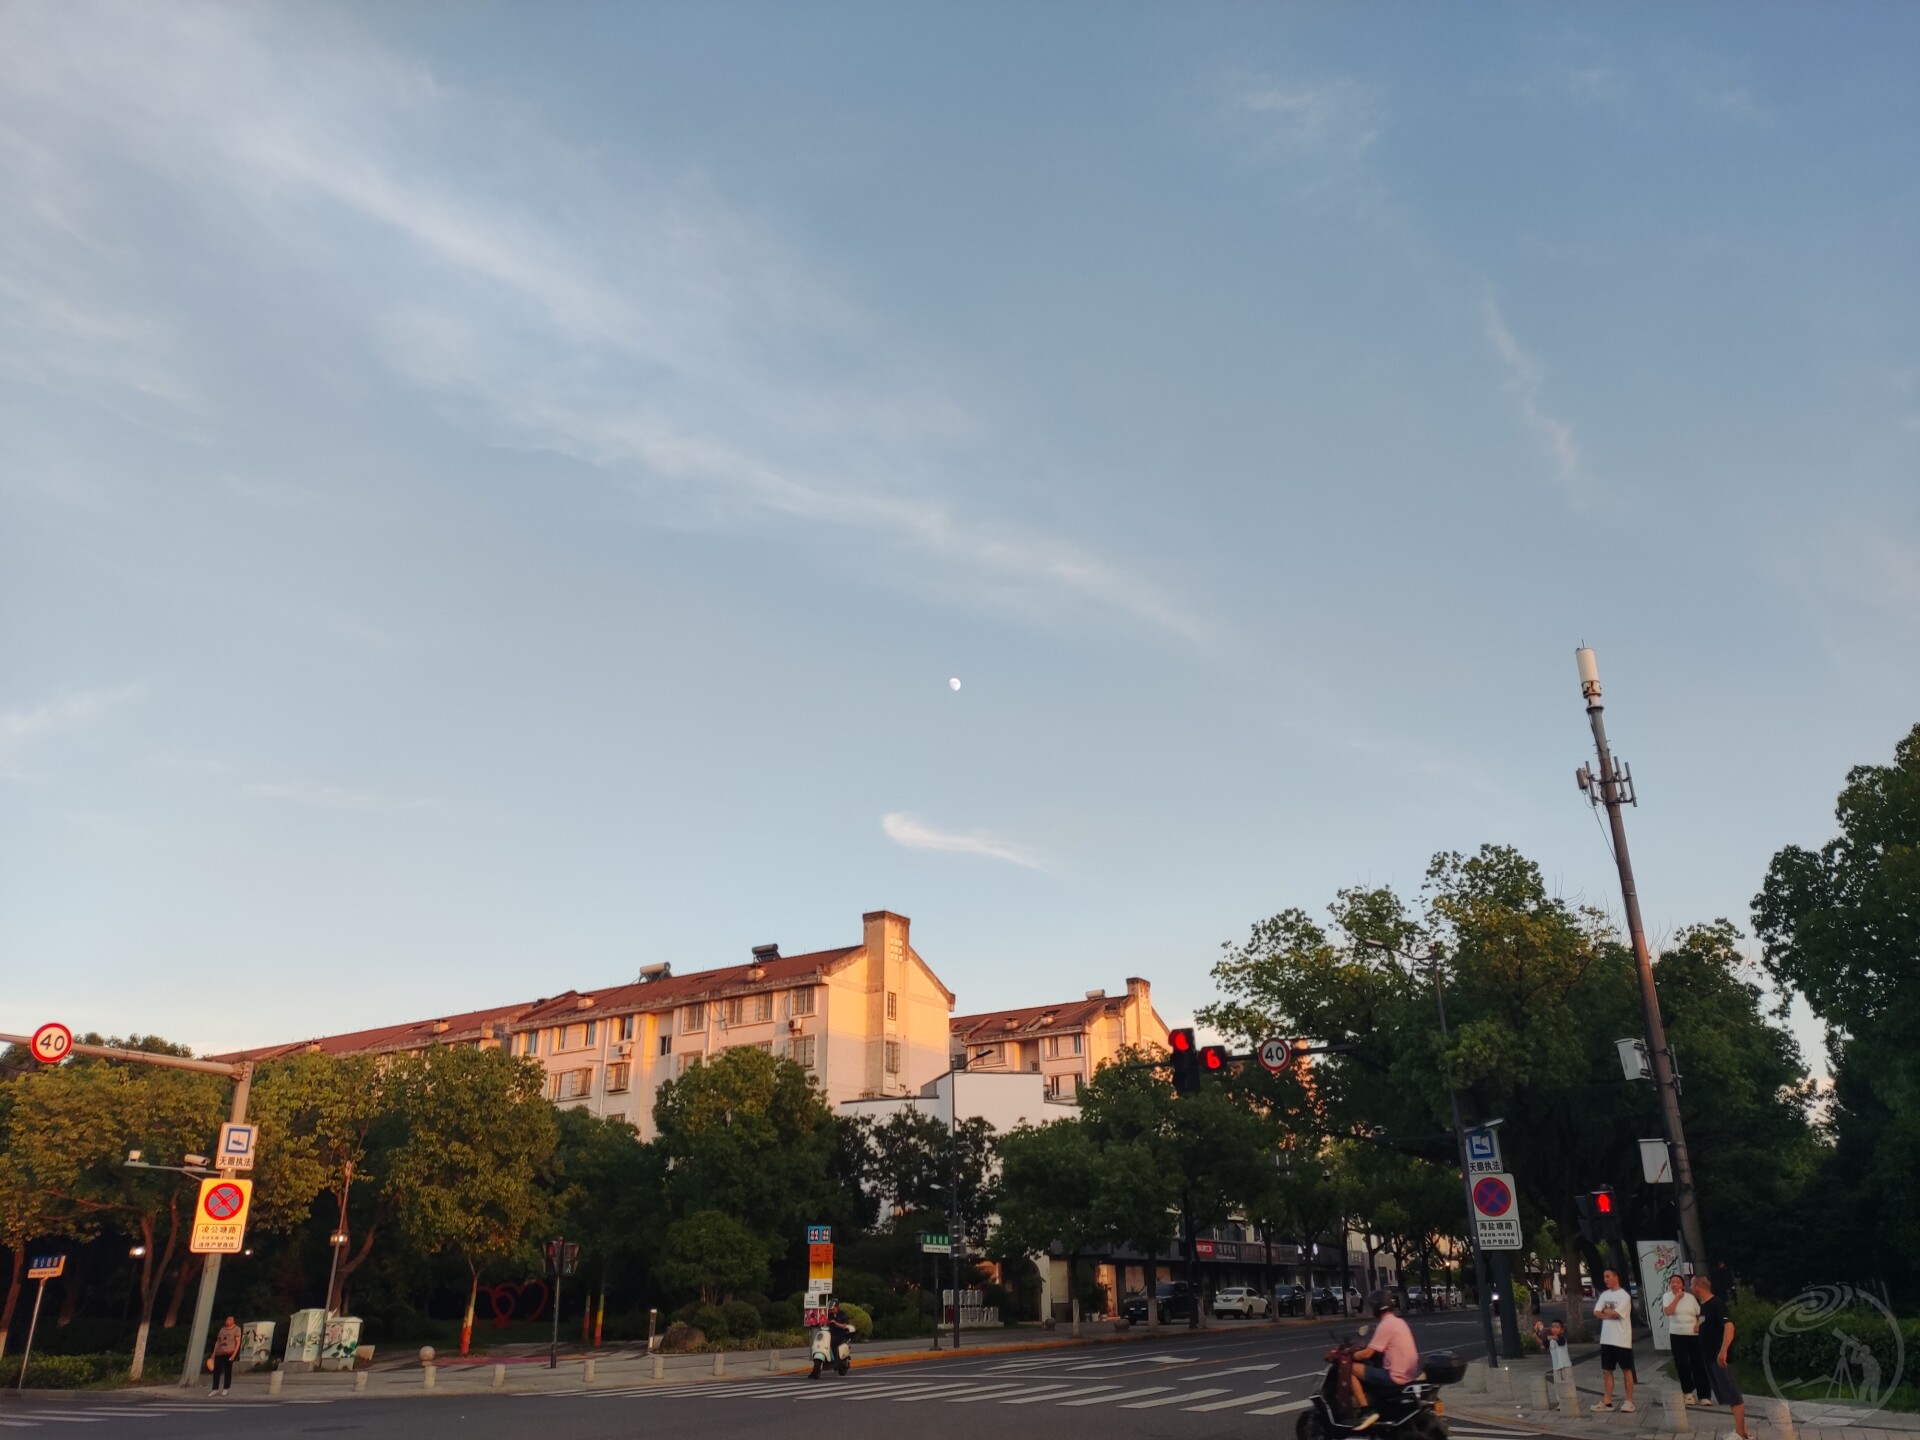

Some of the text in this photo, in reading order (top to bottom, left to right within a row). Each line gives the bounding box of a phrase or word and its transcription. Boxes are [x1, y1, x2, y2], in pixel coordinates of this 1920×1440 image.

[40, 1033, 65, 1051] 40
[1264, 1046, 1285, 1062] 40
[218, 1155, 252, 1167] 天眼执法
[1469, 1160, 1501, 1173] 天眼执法
